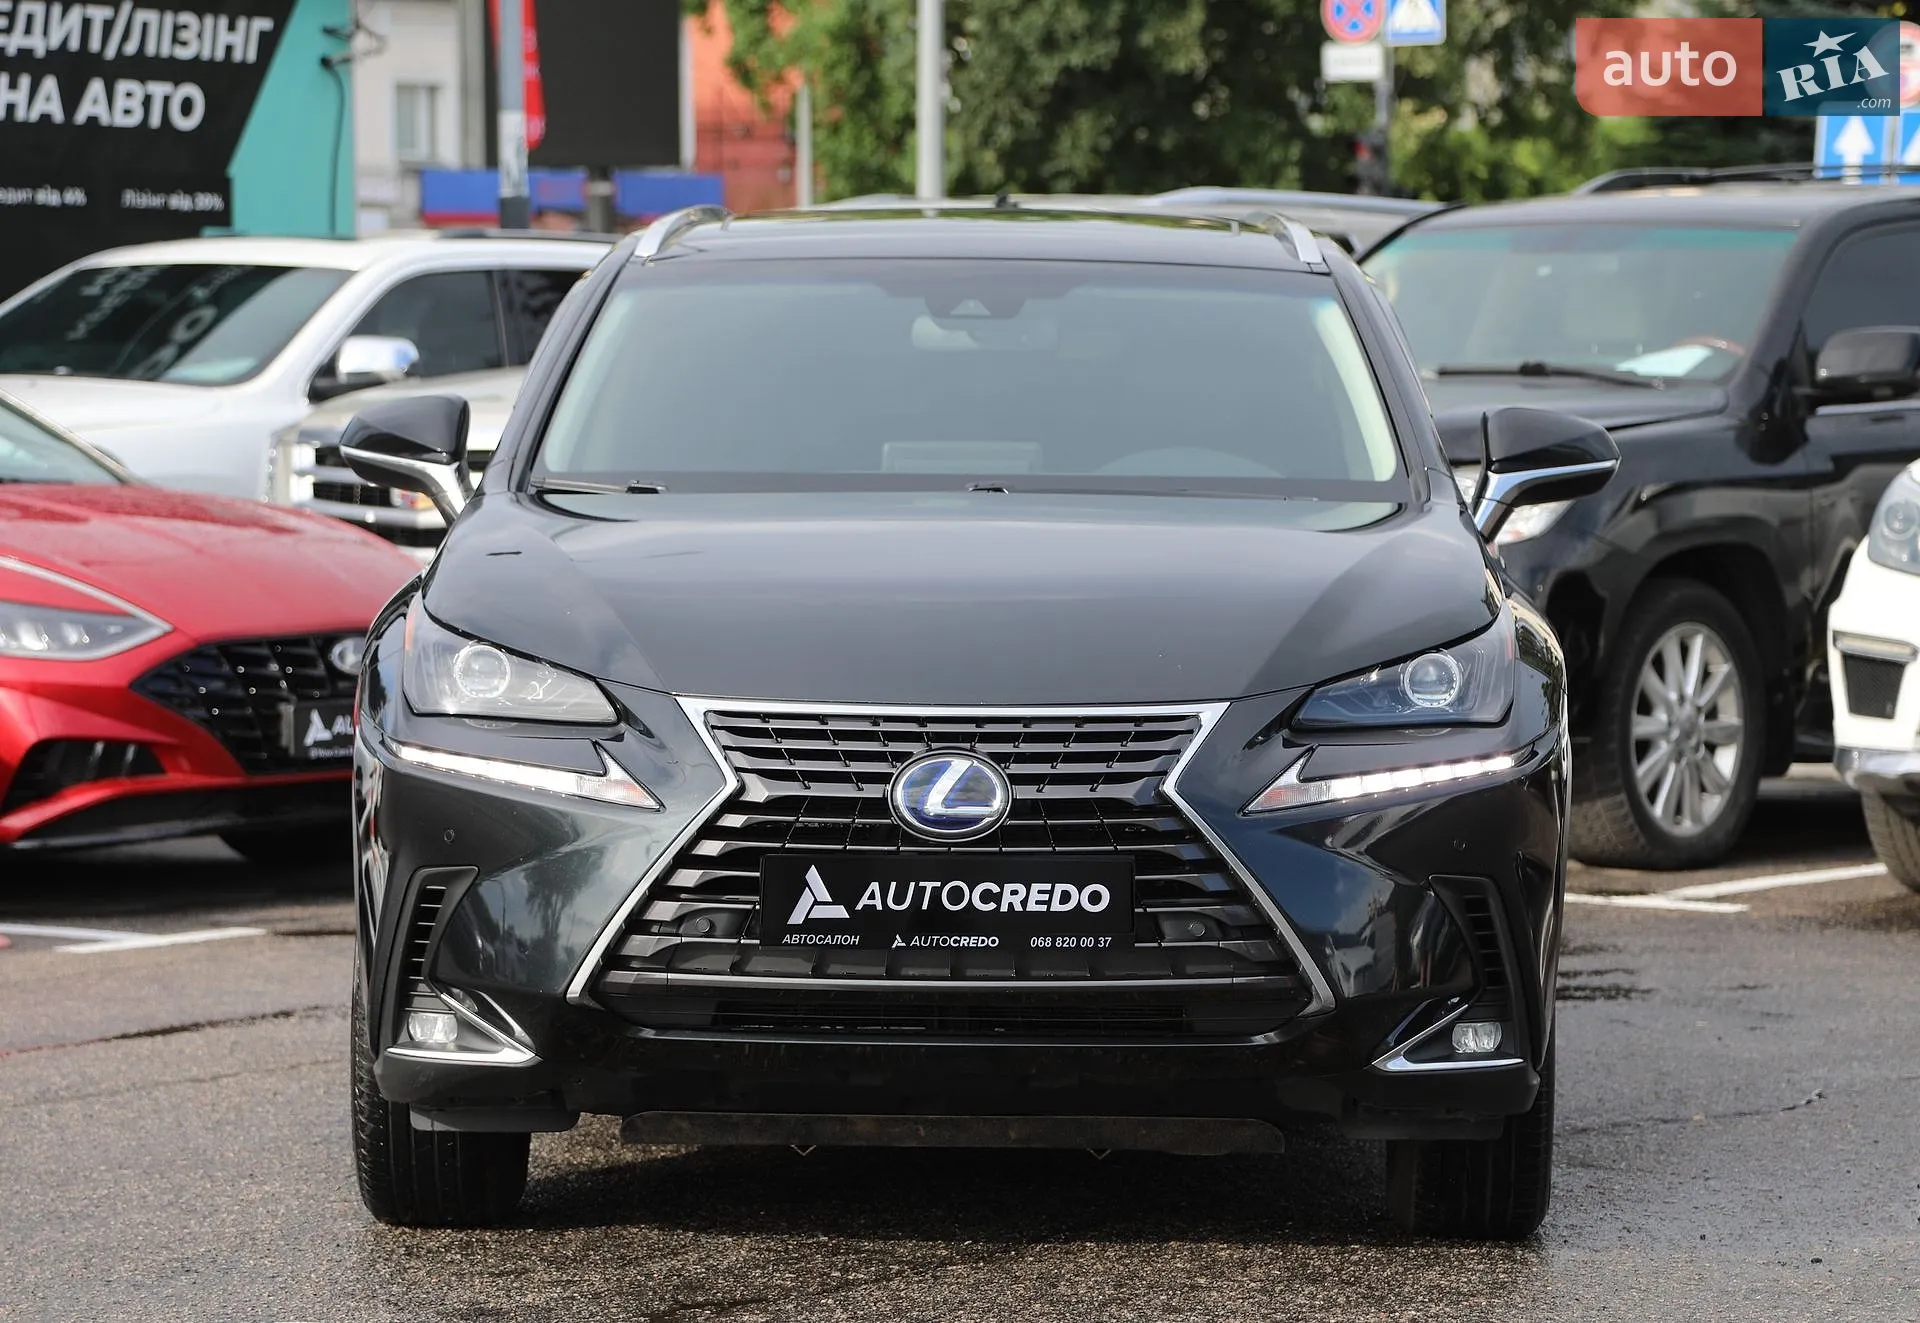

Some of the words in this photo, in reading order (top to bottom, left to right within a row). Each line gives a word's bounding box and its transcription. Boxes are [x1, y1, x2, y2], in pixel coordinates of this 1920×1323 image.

[0, 71, 66, 125] НА
[72, 76, 206, 132] АВТО
[854, 880, 1111, 913] AUTOCREDO
[781, 934, 860, 946] АВТОСАЛОН
[909, 935, 999, 948] AUTOCREDO
[1030, 936, 1052, 948] 068
[1055, 936, 1077, 948] 820
[1080, 936, 1094, 948] 00
[1097, 936, 1112, 948] 37
